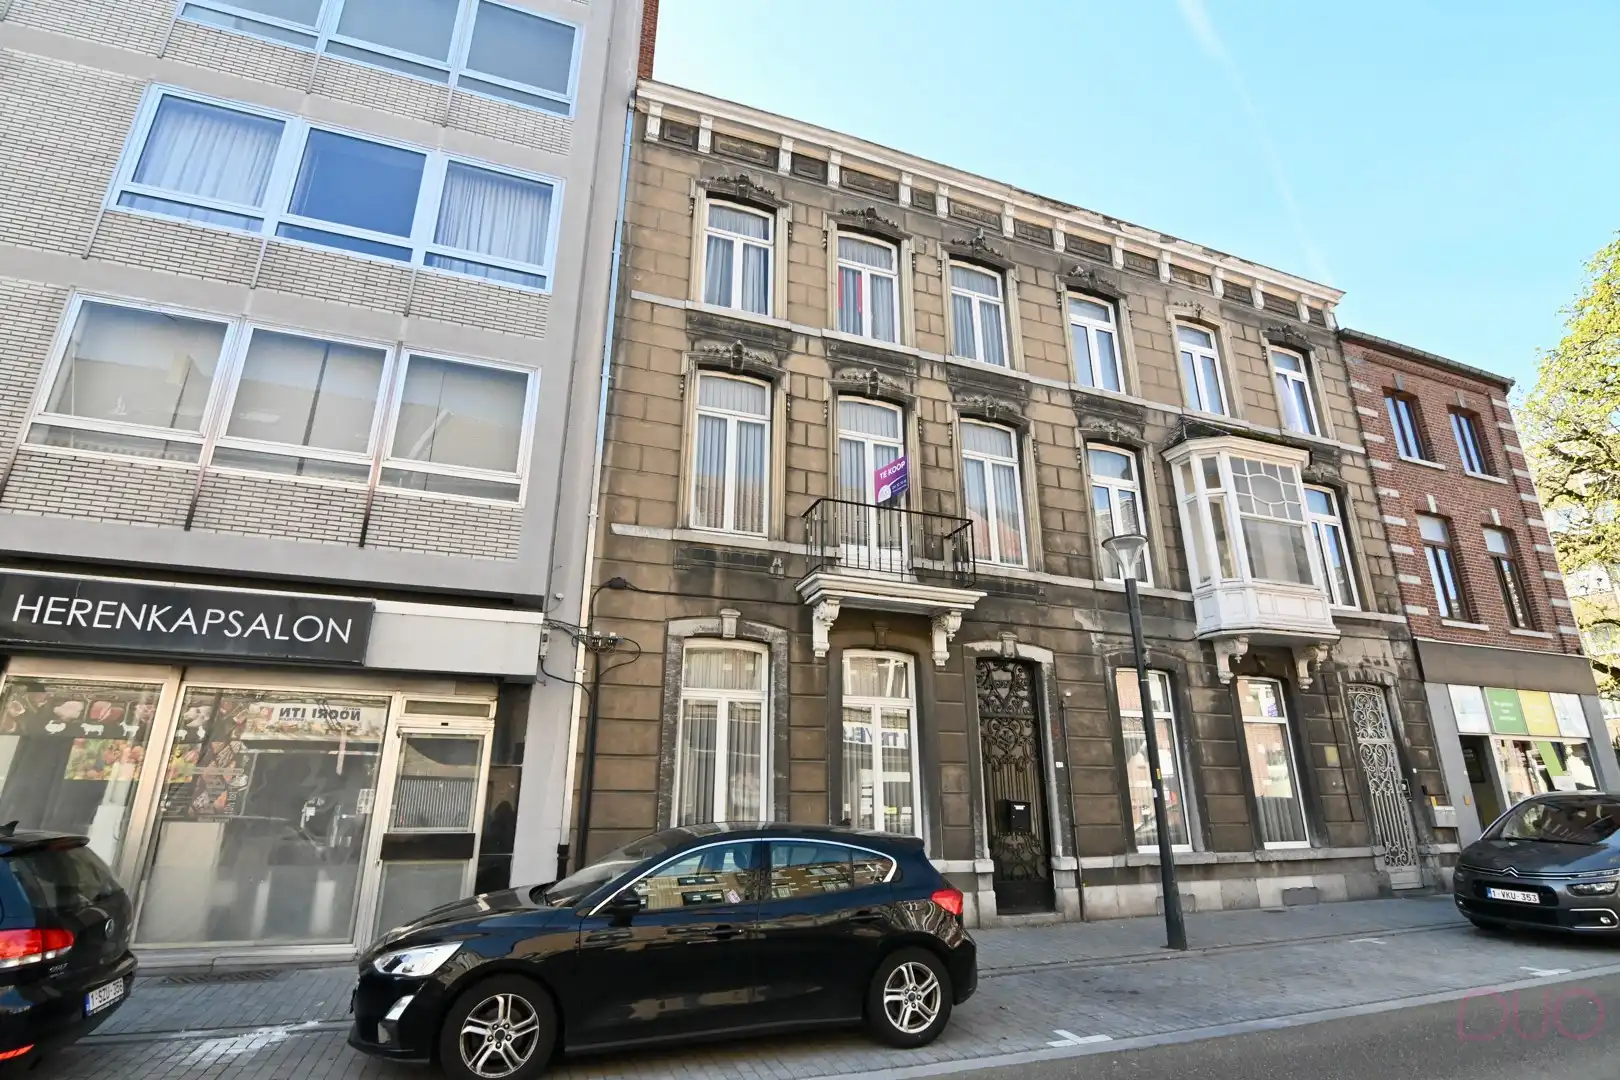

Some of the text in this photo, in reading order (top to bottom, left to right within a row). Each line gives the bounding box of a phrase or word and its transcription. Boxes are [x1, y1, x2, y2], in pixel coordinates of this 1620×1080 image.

[880, 460, 906, 480] TE KOOP
[12, 594, 352, 644] HERENKAPSALON
